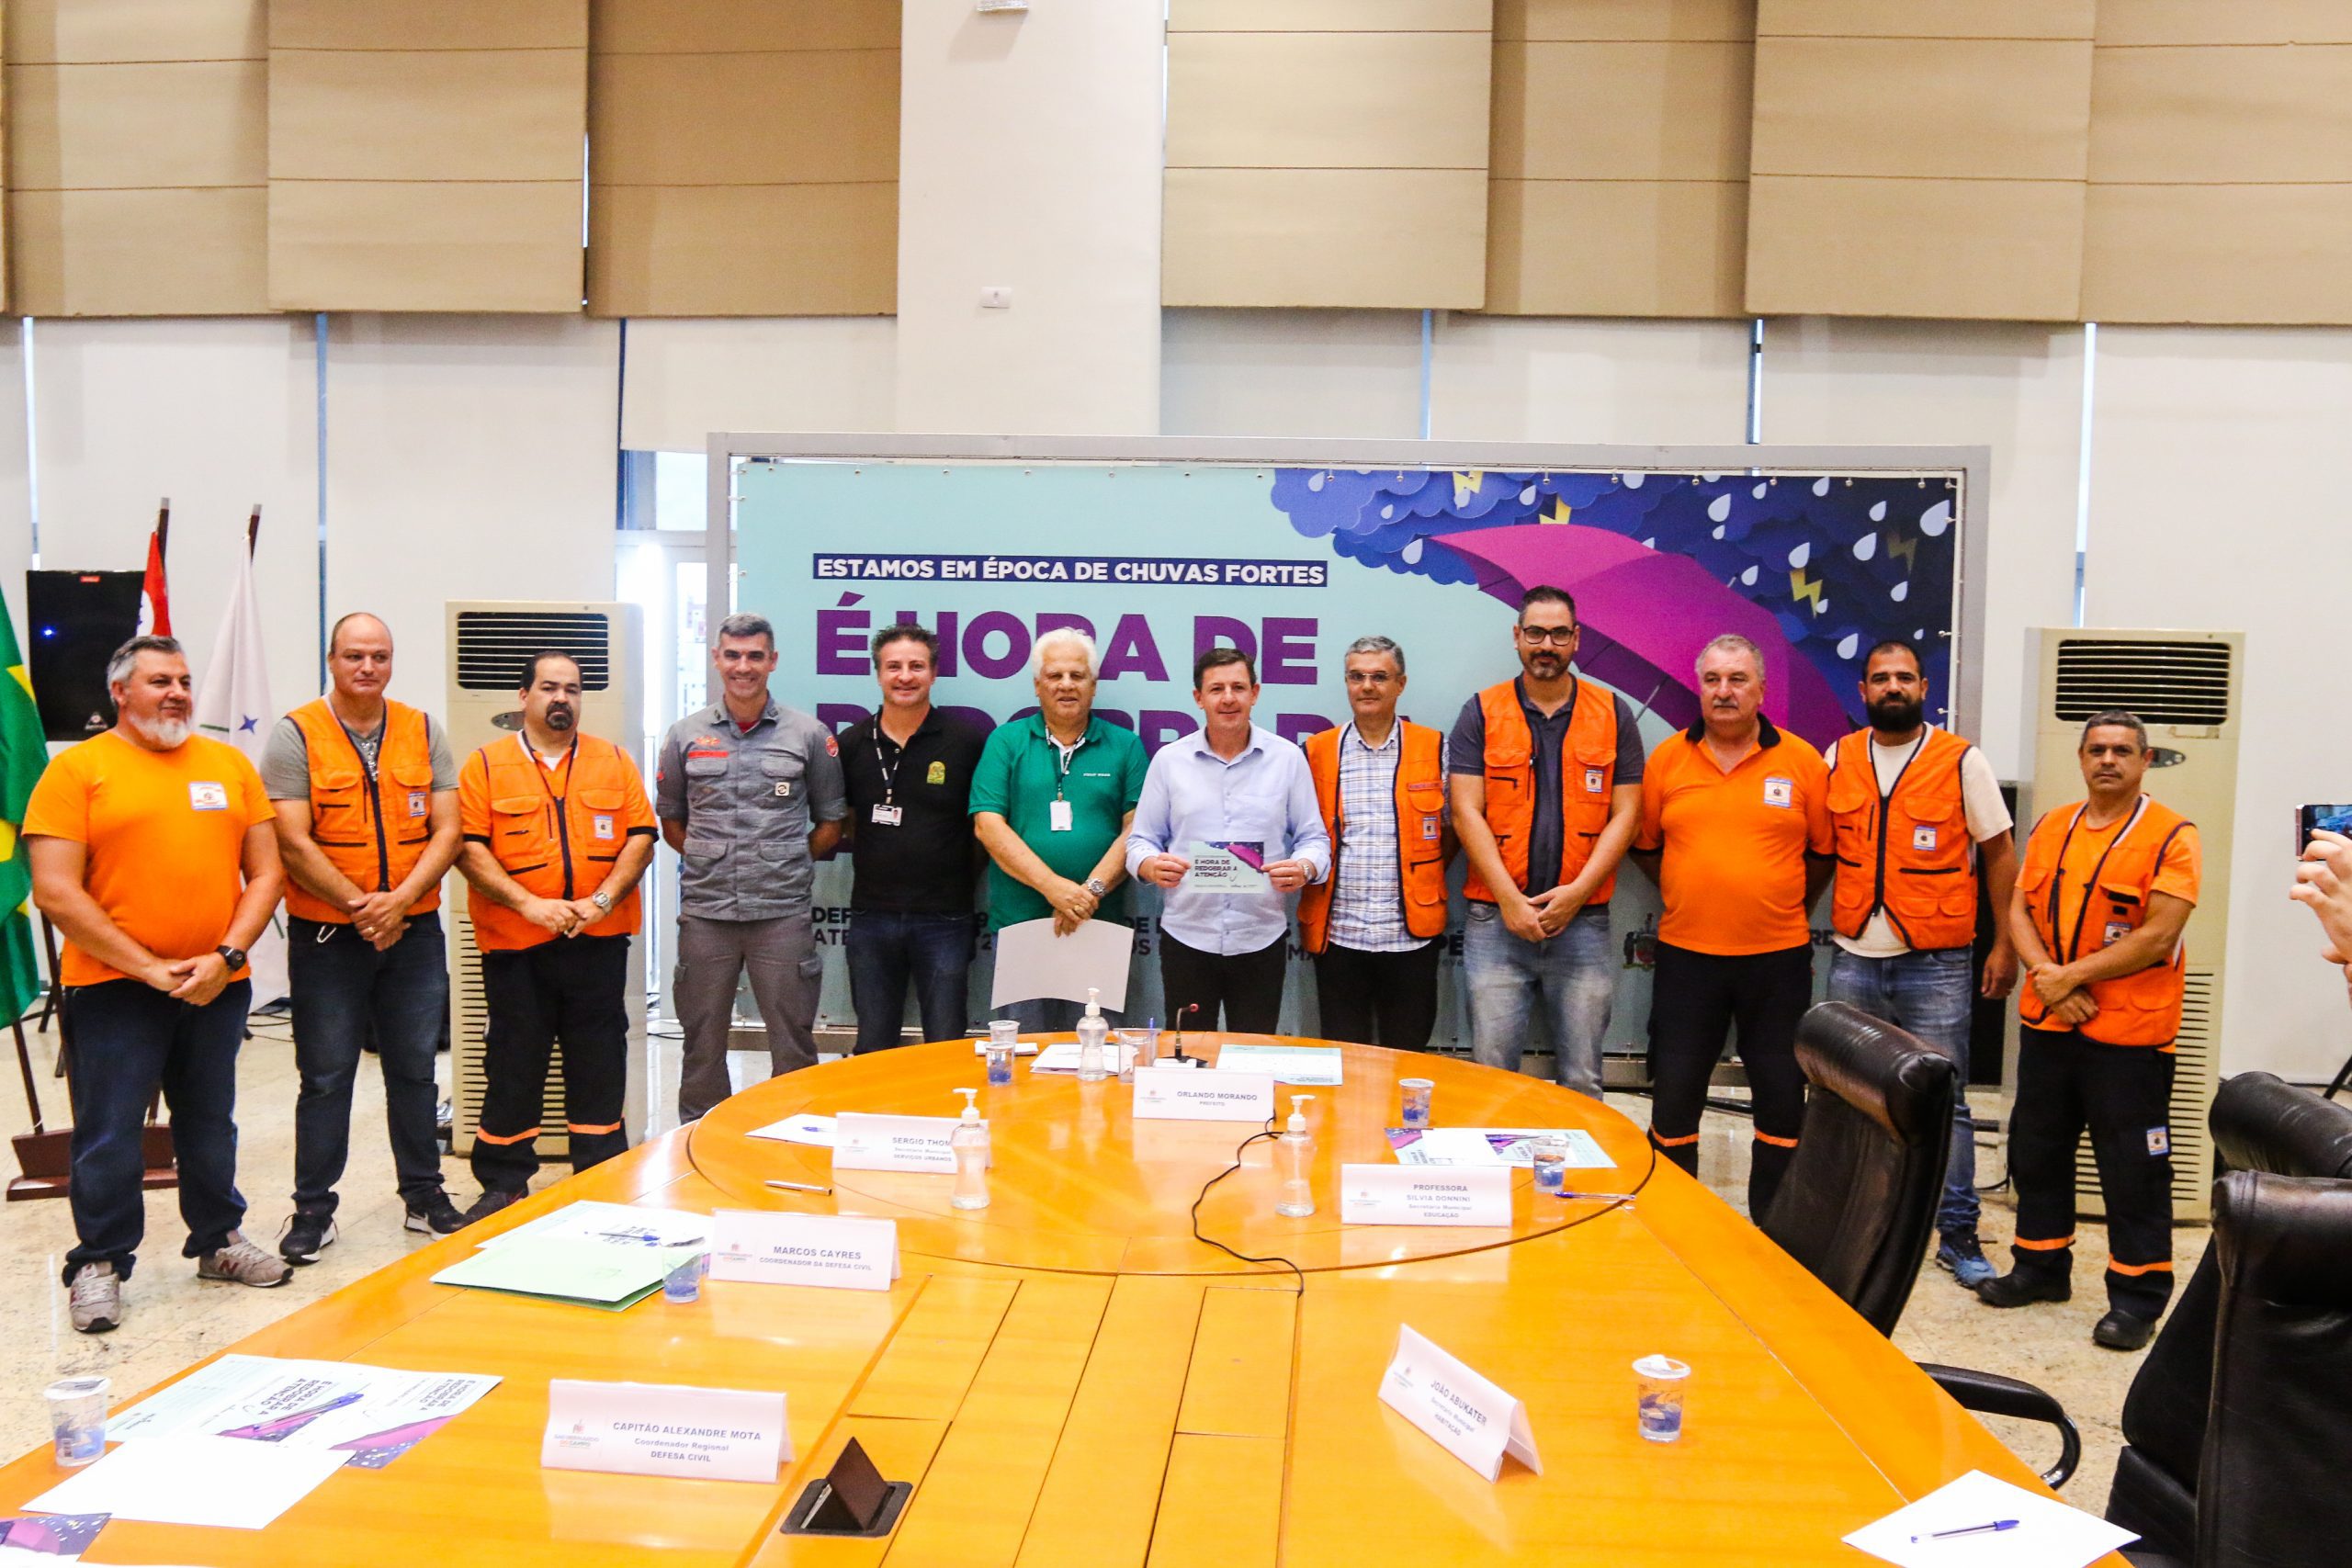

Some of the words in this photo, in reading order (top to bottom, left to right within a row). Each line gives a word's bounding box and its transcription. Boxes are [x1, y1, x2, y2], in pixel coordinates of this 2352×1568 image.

[818, 558, 935, 578] ESTAMOS
[941, 560, 977, 579] EM
[982, 556, 1069, 580] ÉPOCA
[1074, 562, 1108, 581] DE
[1114, 562, 1219, 582] CHUVAS
[1225, 564, 1325, 584] FORTES
[817, 591, 871, 675] É
[1193, 615, 1318, 685] DE
[1177, 1090, 1215, 1100] ORLANDO
[1217, 1092, 1258, 1101] MORANDO
[1413, 1184, 1468, 1192] PROFESSORA
[774, 1246, 817, 1257] MARCOS
[820, 1249, 862, 1259] CAYRES
[760, 1257, 812, 1267] COORDENADOR
[1450, 1394, 1487, 1426] ABUKATER
[613, 1422, 660, 1434] CAPITÃO
[663, 1425, 727, 1438] ALEXANDRE
[729, 1429, 762, 1441] MOTA
[634, 1438, 689, 1449] Coordenador
[692, 1441, 729, 1451] Regional
[650, 1450, 685, 1460] DEFESA
[687, 1453, 711, 1462] CIVIL
